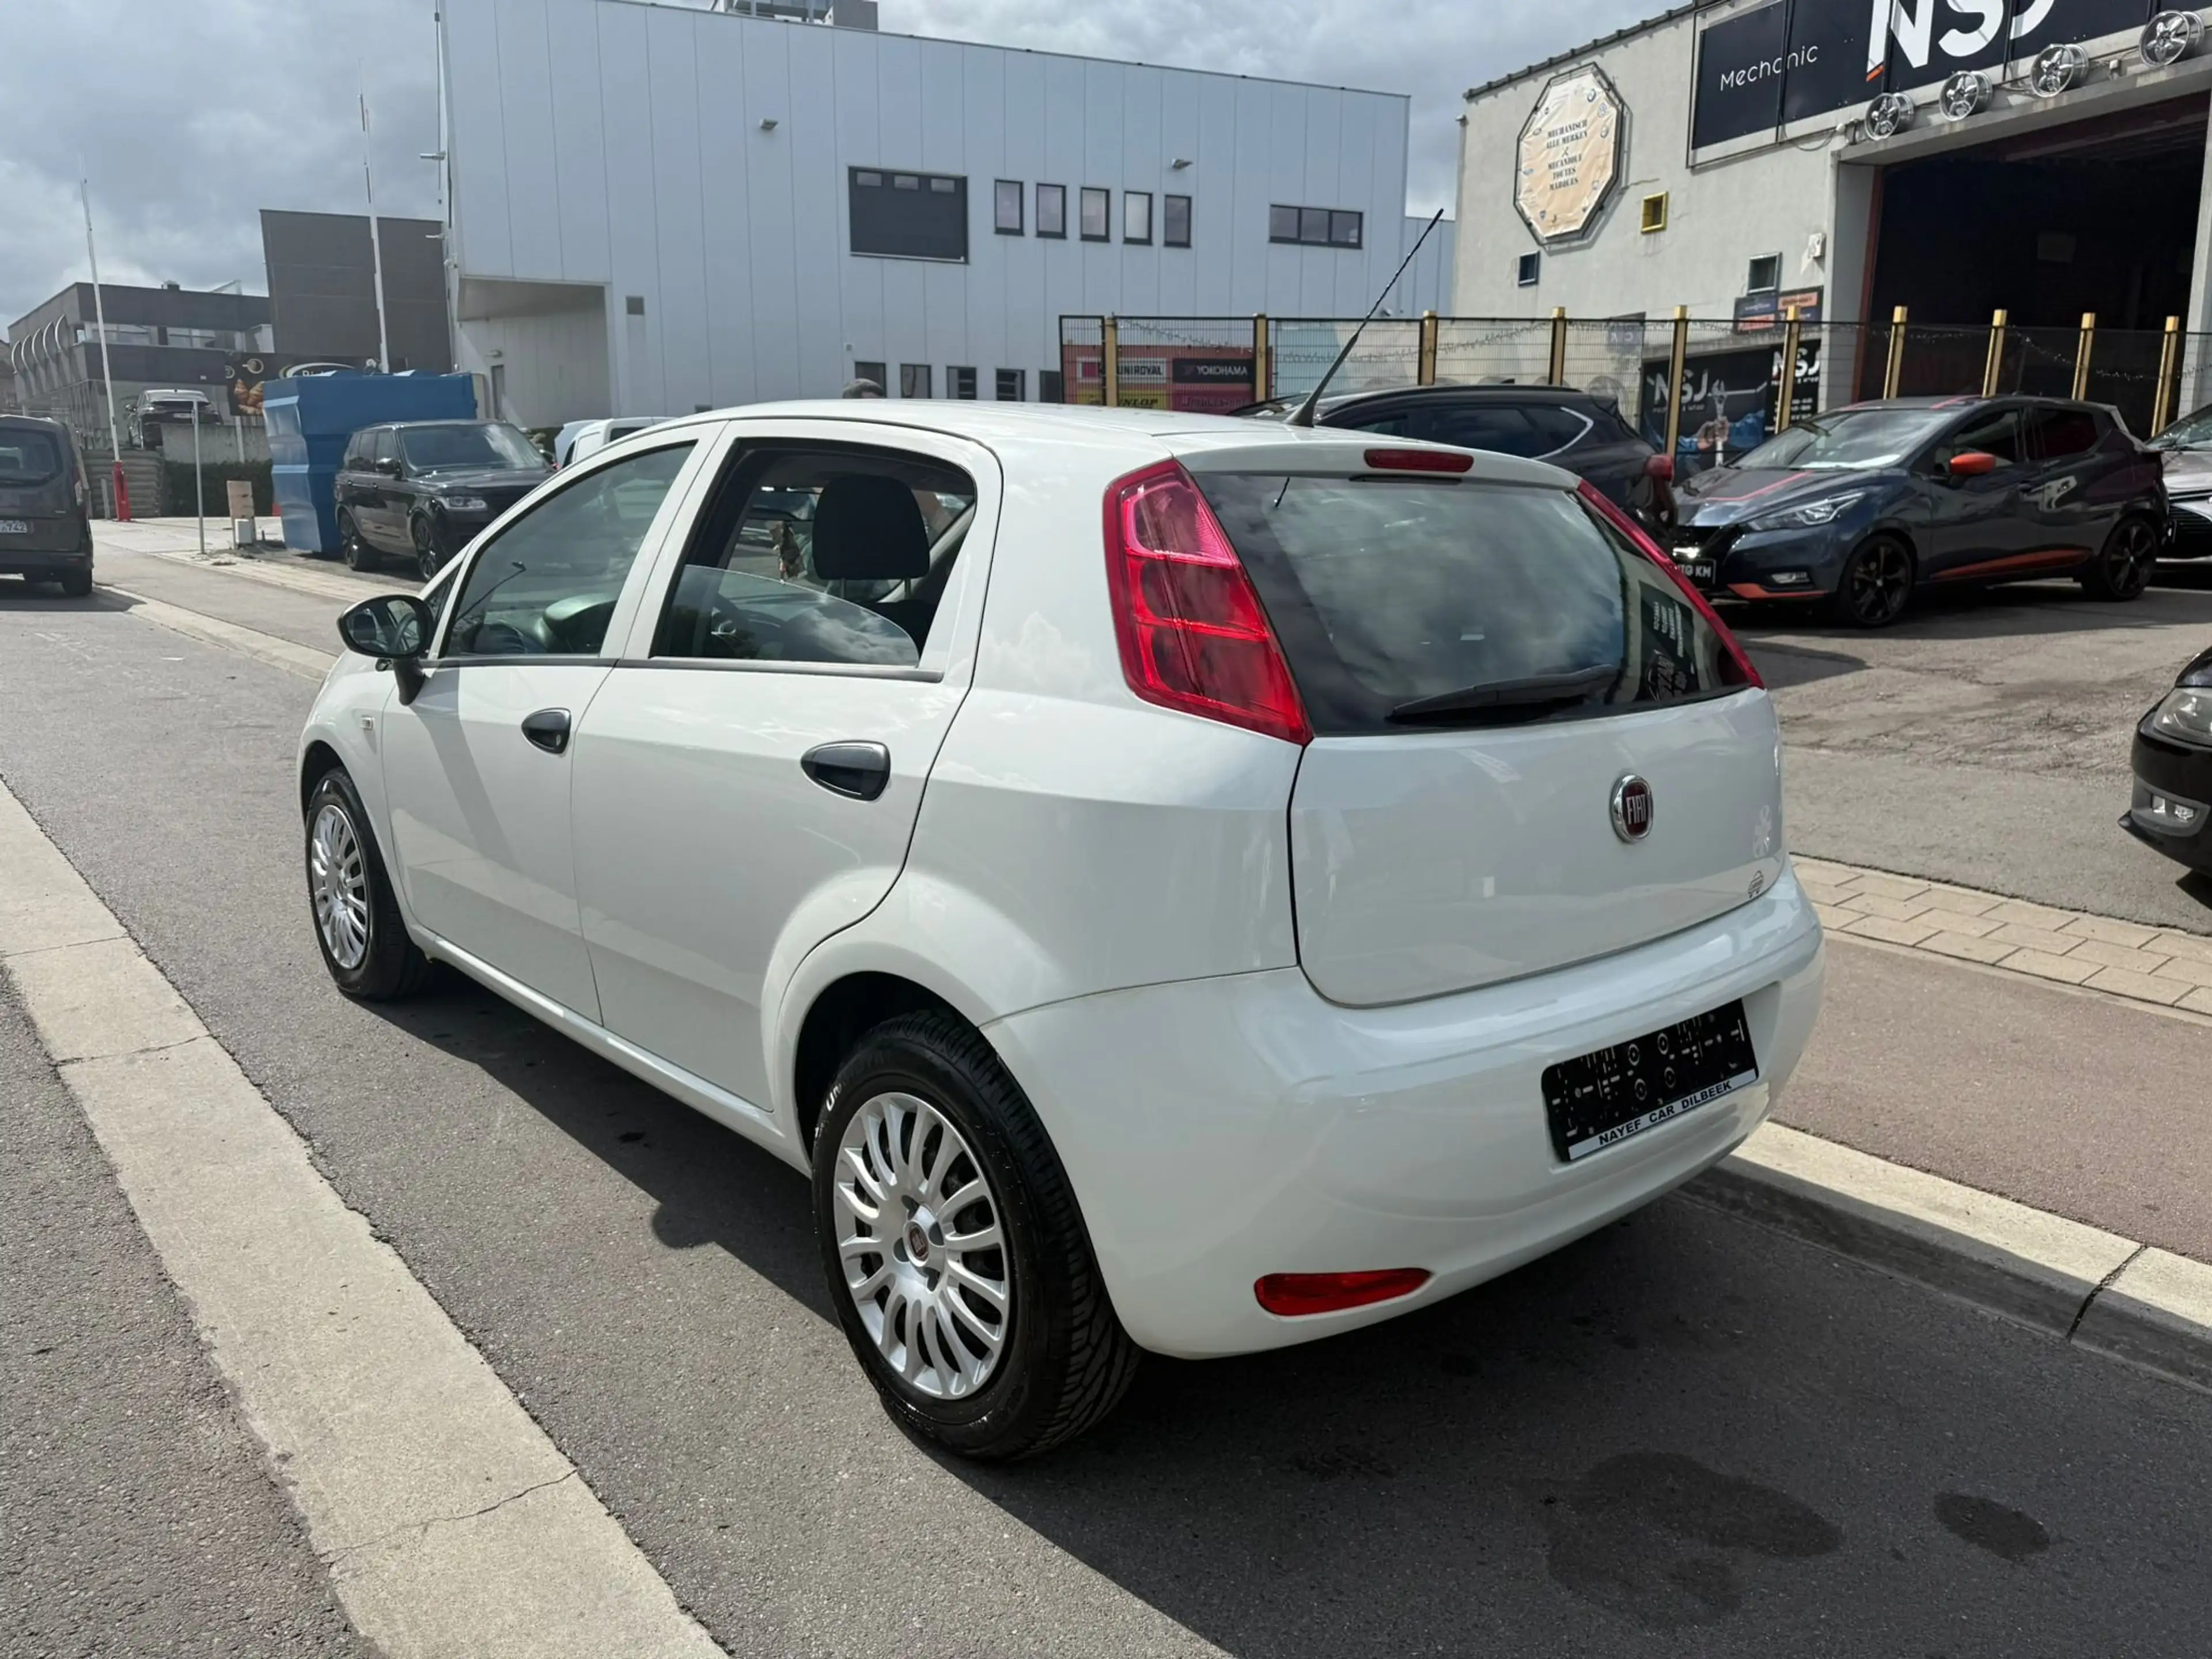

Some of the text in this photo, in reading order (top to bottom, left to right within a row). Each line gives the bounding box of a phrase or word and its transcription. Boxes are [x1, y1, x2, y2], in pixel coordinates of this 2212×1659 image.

[1720, 46, 1819, 92] Mechanic
[1197, 364, 1248, 375] YOKOHAMA
[1695, 565, 1711, 578] KM
[1626, 794, 1646, 825] FIAT
[1599, 1080, 1732, 1146] NAYEF CAR DILBEEK
